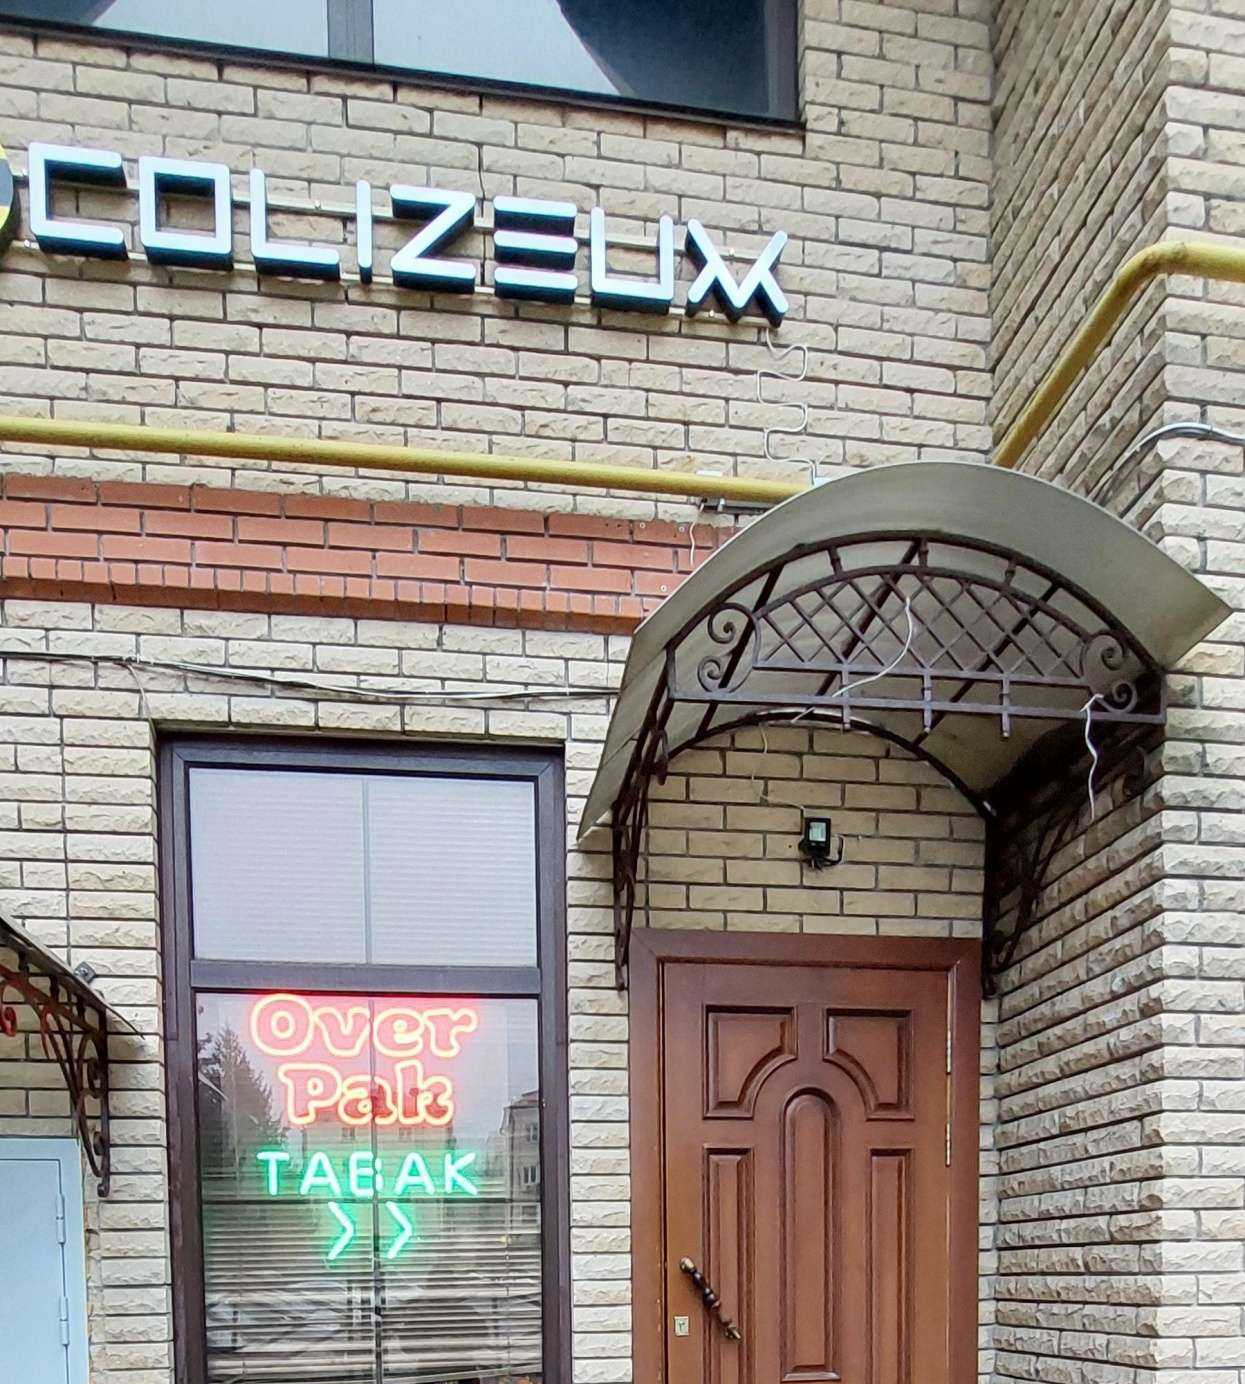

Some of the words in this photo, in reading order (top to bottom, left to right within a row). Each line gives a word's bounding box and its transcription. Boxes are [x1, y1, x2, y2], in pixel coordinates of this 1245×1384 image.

[27, 141, 790, 328] COLIZEUM
[251, 993, 478, 1057] Over
[278, 1059, 454, 1125] Pak
